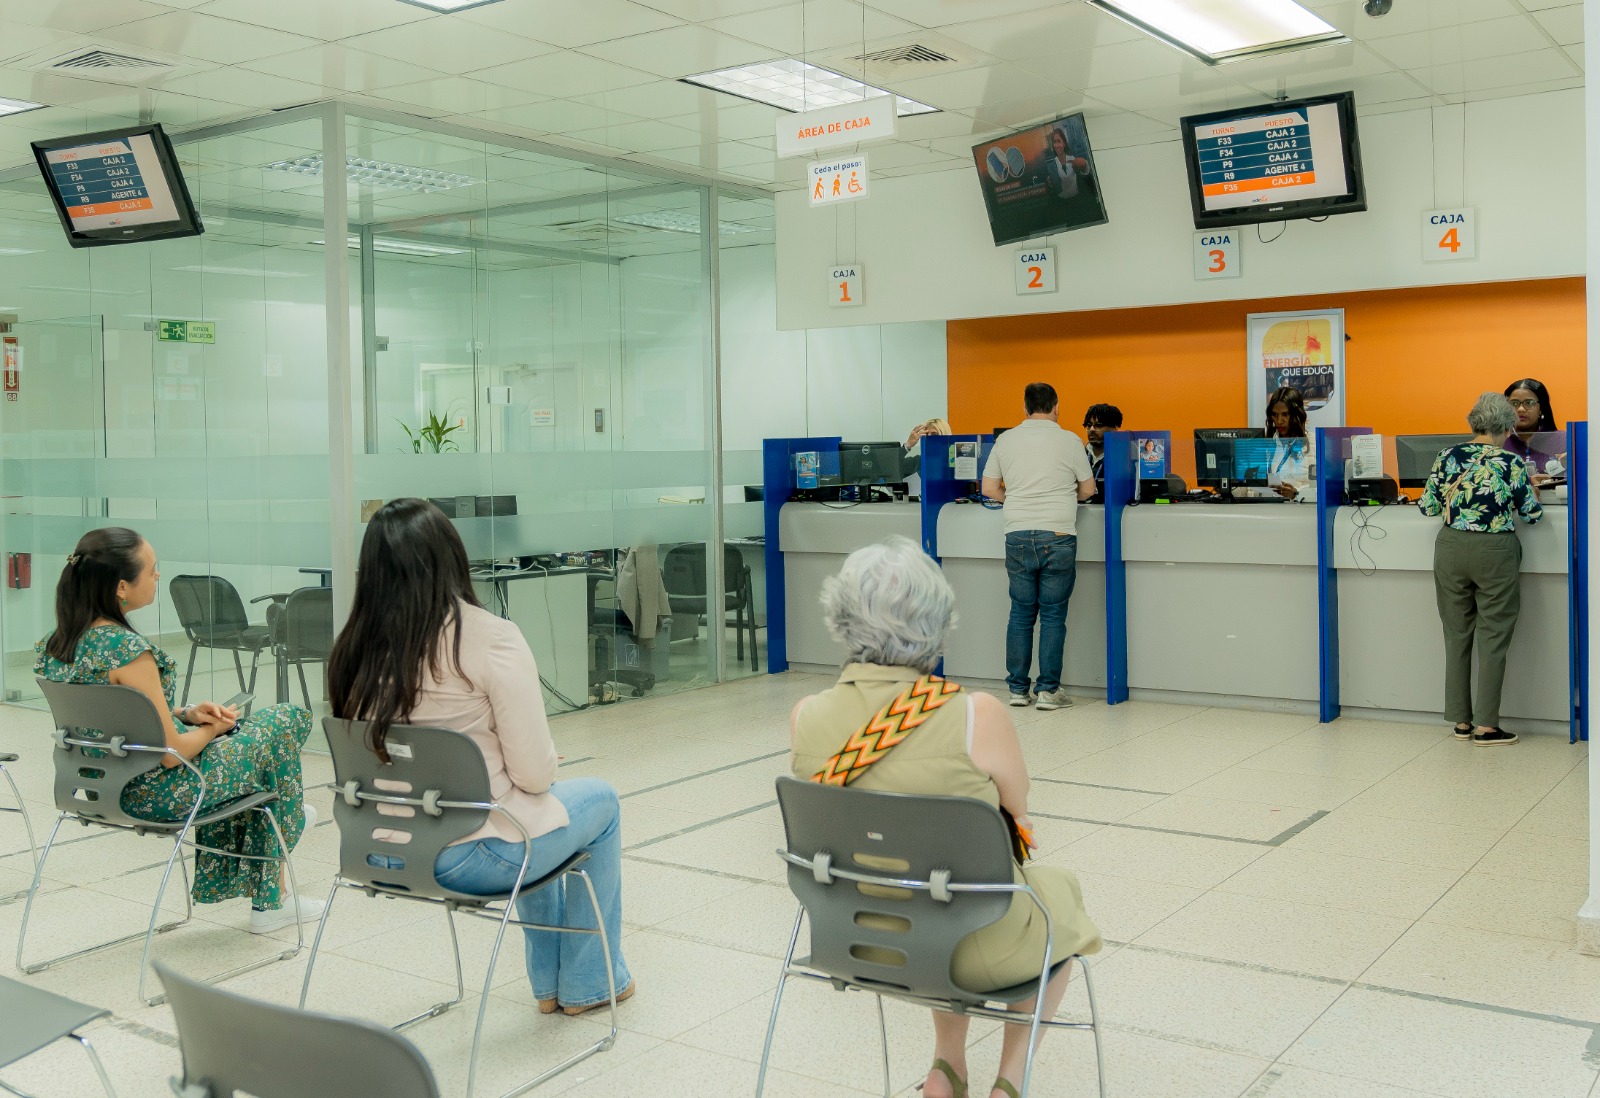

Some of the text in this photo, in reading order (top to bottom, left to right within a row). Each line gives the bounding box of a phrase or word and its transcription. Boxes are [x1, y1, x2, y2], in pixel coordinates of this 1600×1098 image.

[798, 116, 871, 140] ÁREA DE CAJA
[1211, 118, 1294, 135] TURNO PUESTO
[1217, 128, 1295, 146] F33 CAJA 2
[1219, 140, 1297, 157] F34 CAJA 2
[59, 152, 77, 160] TURNO
[103, 157, 119, 166] CAJA
[120, 155, 126, 163] 2
[1268, 153, 1292, 162] CAJA
[1292, 152, 1298, 160] 4
[71, 167, 130, 181] F34 CAJA 2
[814, 166, 832, 175] Ceda
[1224, 172, 1235, 180] R9
[1264, 163, 1299, 175] AGENTE
[111, 179, 127, 188] CAJA
[1272, 176, 1295, 186] CAJA
[80, 189, 142, 203] R9 AGENTE 4
[119, 201, 135, 210] CAJA
[1430, 213, 1465, 225] CAJA
[1201, 235, 1231, 246] CAJA
[1438, 227, 1461, 253] 4
[1021, 253, 1047, 263] CAJA
[1208, 249, 1226, 273] 3
[833, 269, 856, 278] CAJA
[1028, 266, 1043, 289] 2
[839, 281, 852, 302] 1
[1263, 355, 1312, 368] ENERGÍA
[1282, 366, 1334, 377] QUE EDUCA
